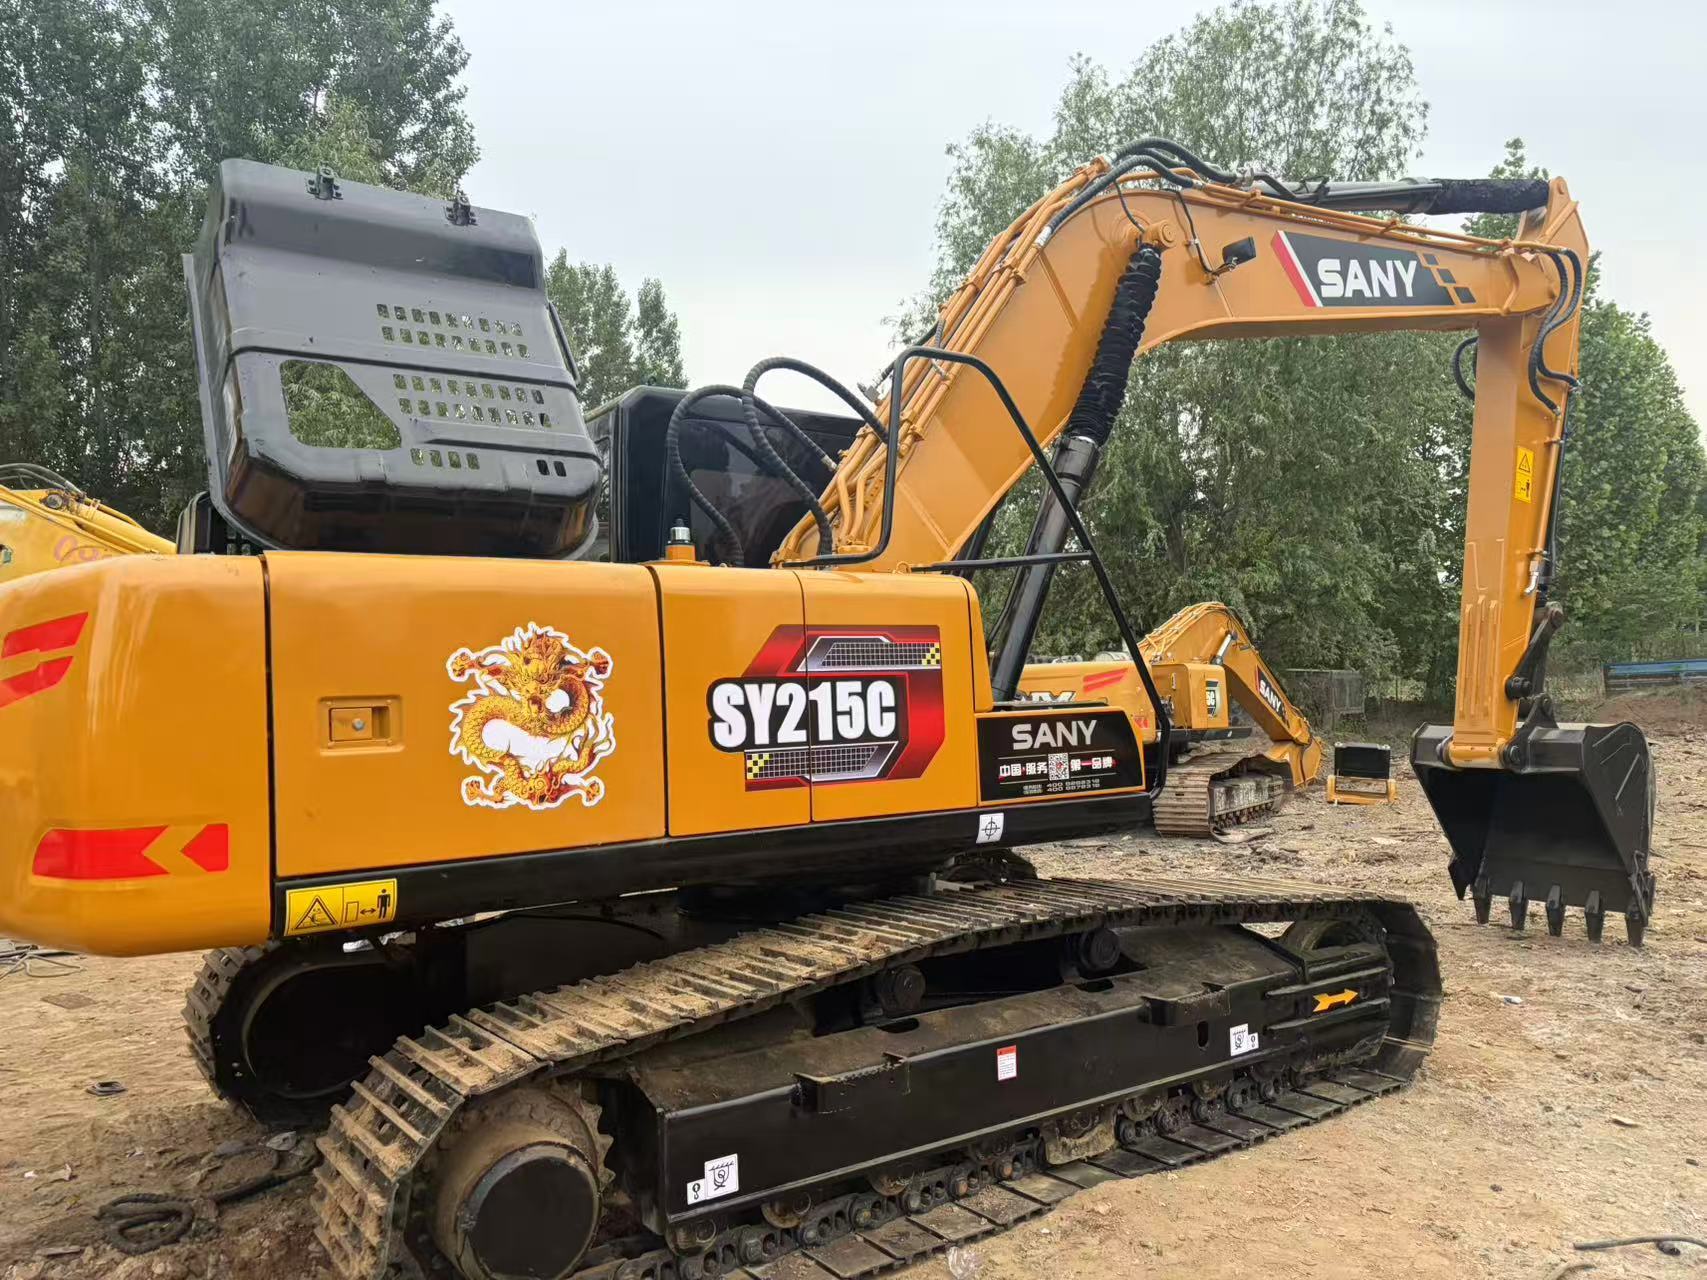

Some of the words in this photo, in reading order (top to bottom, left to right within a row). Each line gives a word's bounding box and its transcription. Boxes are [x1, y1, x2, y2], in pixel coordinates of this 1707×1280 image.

[1317, 258, 1417, 297] SANY
[1259, 679, 1281, 712] SANY
[712, 680, 896, 748] SY215C
[1011, 719, 1097, 750] SANY
[1070, 756, 1112, 772] 第一品牌
